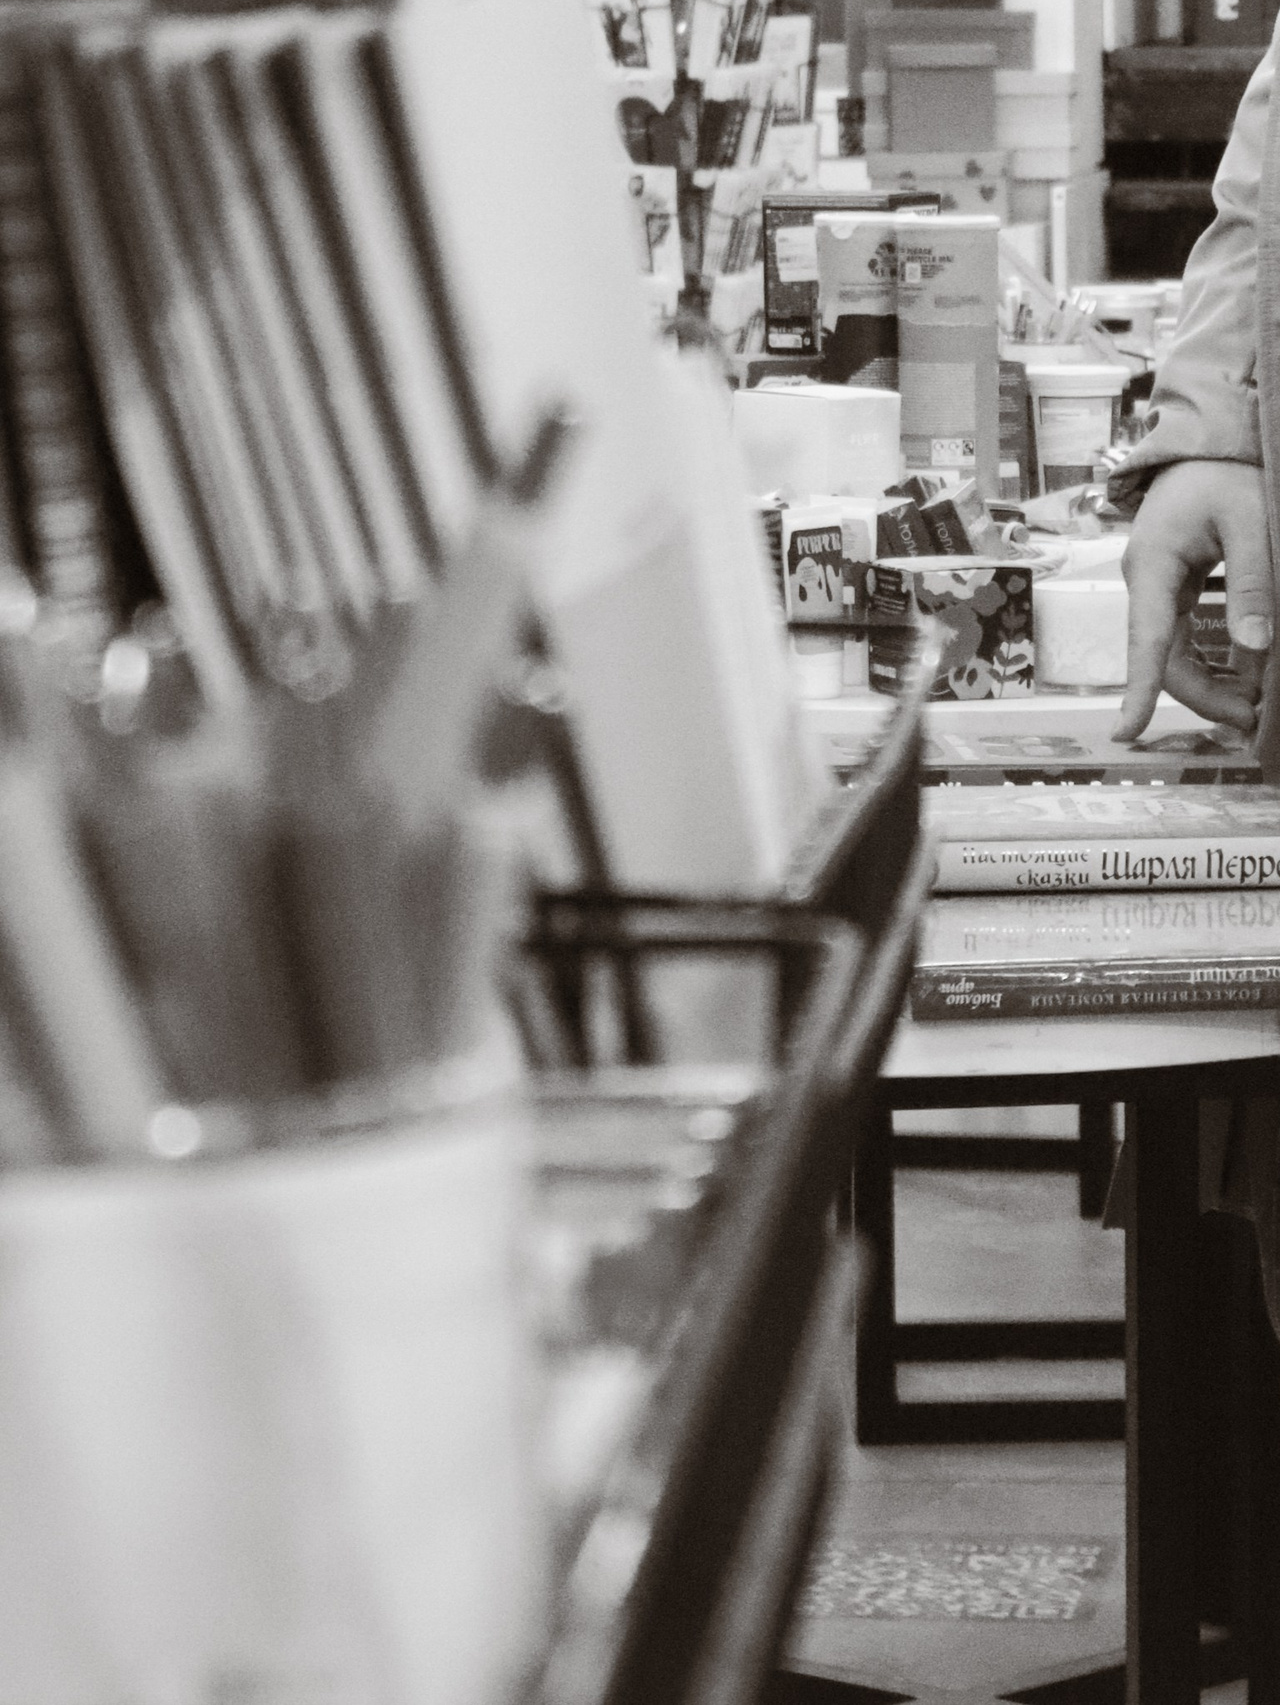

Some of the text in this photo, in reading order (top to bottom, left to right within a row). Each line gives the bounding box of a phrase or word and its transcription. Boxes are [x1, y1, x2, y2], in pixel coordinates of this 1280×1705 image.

[1100, 848, 1197, 884] Шарля
[1015, 868, 1091, 888] сказки
[944, 992, 1003, 1009] Библио
[1119, 987, 1261, 1005] БОЖЕСТВЕННАЯ
